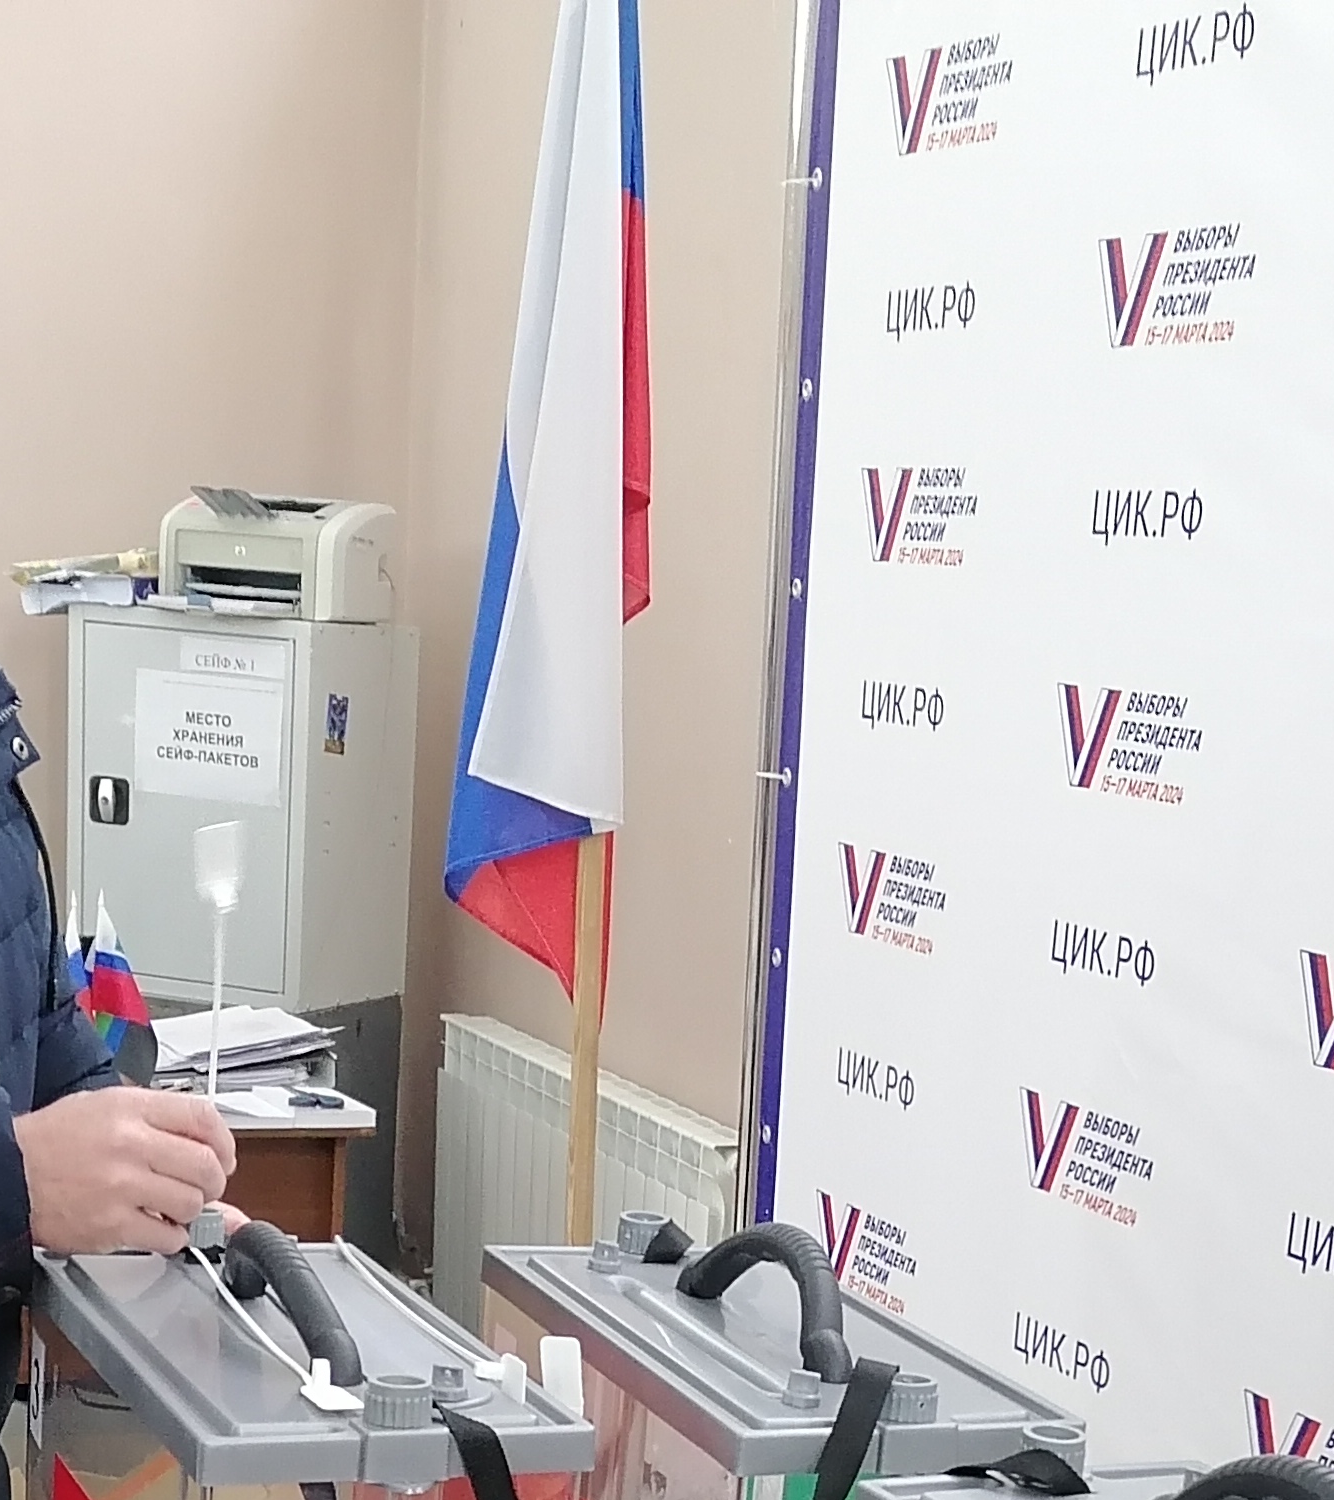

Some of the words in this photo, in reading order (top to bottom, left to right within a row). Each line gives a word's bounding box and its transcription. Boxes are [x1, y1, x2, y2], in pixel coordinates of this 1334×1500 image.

[947, 32, 1000, 66] ВЫБОРЫ
[1136, 2, 1256, 87] ЦИК.РФ
[939, 60, 1013, 97] ПРЕЗИДЕНТА
[932, 96, 978, 127] РОССИИ
[1174, 222, 1240, 253] ВЫБОРЫ
[1162, 254, 1256, 286] ПРЕЗИДЕНТА
[886, 281, 976, 342] ЦИК.РФ
[1152, 291, 1212, 318] РОССИИ
[917, 467, 966, 488] ВЫБОРЫ
[910, 494, 978, 519] ПРЕЗИДЕНТА
[1091, 487, 1204, 546] ЦИК.РФ
[903, 521, 947, 542] РОССИИ
[185, 711, 232, 728] МЕСТО
[862, 679, 945, 732] ЦИК.РФ
[1126, 691, 1188, 718] ВЫБОРЫ
[172, 728, 244, 748] ХРАНЕНИЯ
[1116, 720, 1203, 751] ПРЕЗИДЕНТА
[157, 745, 259, 768] СЕЙФ-ПАКЕТОВ
[1107, 748, 1163, 775] РОССИИ
[890, 855, 936, 882] ВЫБОРЫ
[883, 879, 946, 912] ПРЕЗИДЕНТА
[876, 902, 918, 928] РОССИИ
[1051, 917, 1156, 987] ЦИК.РФ
[836, 1045, 916, 1111] ЦИК.РФ
[1083, 1110, 1141, 1147] ВЫБОРЫ
[1074, 1135, 1154, 1181] ПРЕЗИДЕНТА
[1065, 1160, 1117, 1195] РОССИИ
[864, 1213, 907, 1247] ВЫБОРЫ
[851, 1255, 891, 1286] РОССИИ
[857, 1234, 917, 1277] ПРЕЗИДЕНТА
[1012, 1310, 1111, 1395] ЦИК.РФ
